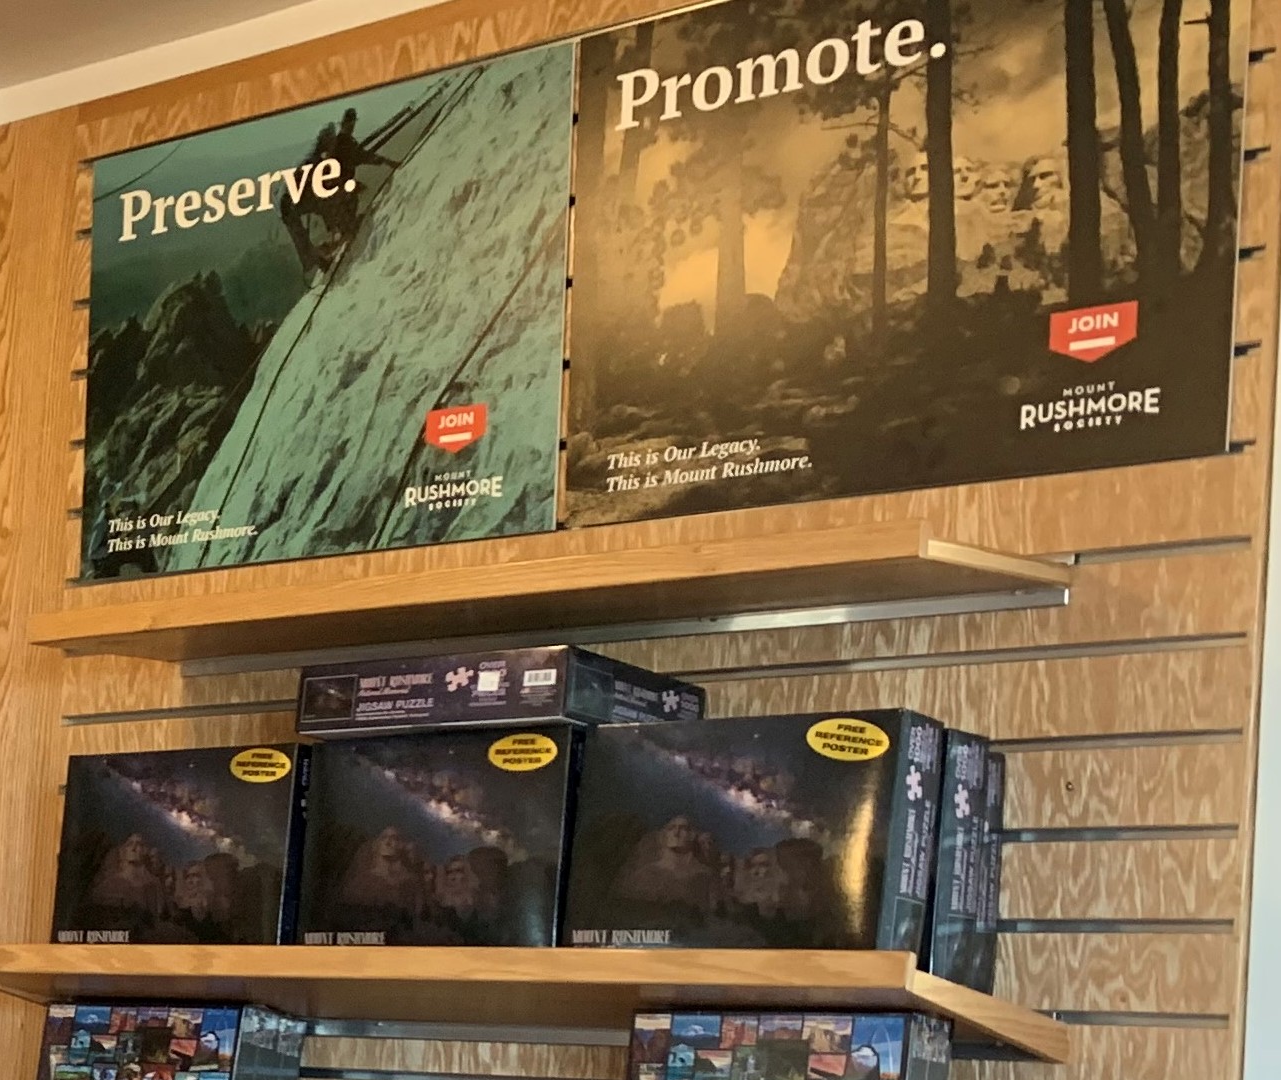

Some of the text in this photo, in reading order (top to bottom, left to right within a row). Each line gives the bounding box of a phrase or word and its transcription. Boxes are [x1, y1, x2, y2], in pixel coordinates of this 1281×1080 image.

[614, 17, 947, 131] Promote.
[118, 155, 356, 242] Preserve.
[1068, 312, 1119, 334] JOIN
[1063, 381, 1115, 397] MOUNT
[1020, 387, 1161, 430] RUSHMORE
[438, 411, 475, 429] JOIN
[1054, 415, 1122, 432] SOCIETY
[607, 438, 761, 470] This is Our Legacy.
[435, 470, 472, 481] MOUNT
[606, 455, 812, 493] This is Mount Rushmore.
[405, 476, 503, 508] RUSHMORE
[108, 509, 221, 534] This is Our Legacy.
[107, 525, 259, 553] This is Mount Rushmore.
[356, 698, 434, 713] JIGSAW PUZZLE
[837, 724, 867, 734] FREE
[512, 738, 537, 747] FREE
[815, 731, 884, 746] REFERENCE
[251, 752, 274, 760] FREE
[495, 747, 552, 756] REFERENCE
[822, 742, 869, 755] POSTER
[236, 761, 286, 769] REFERENCE
[502, 756, 542, 765] POSTER
[242, 769, 277, 777] POSTER
